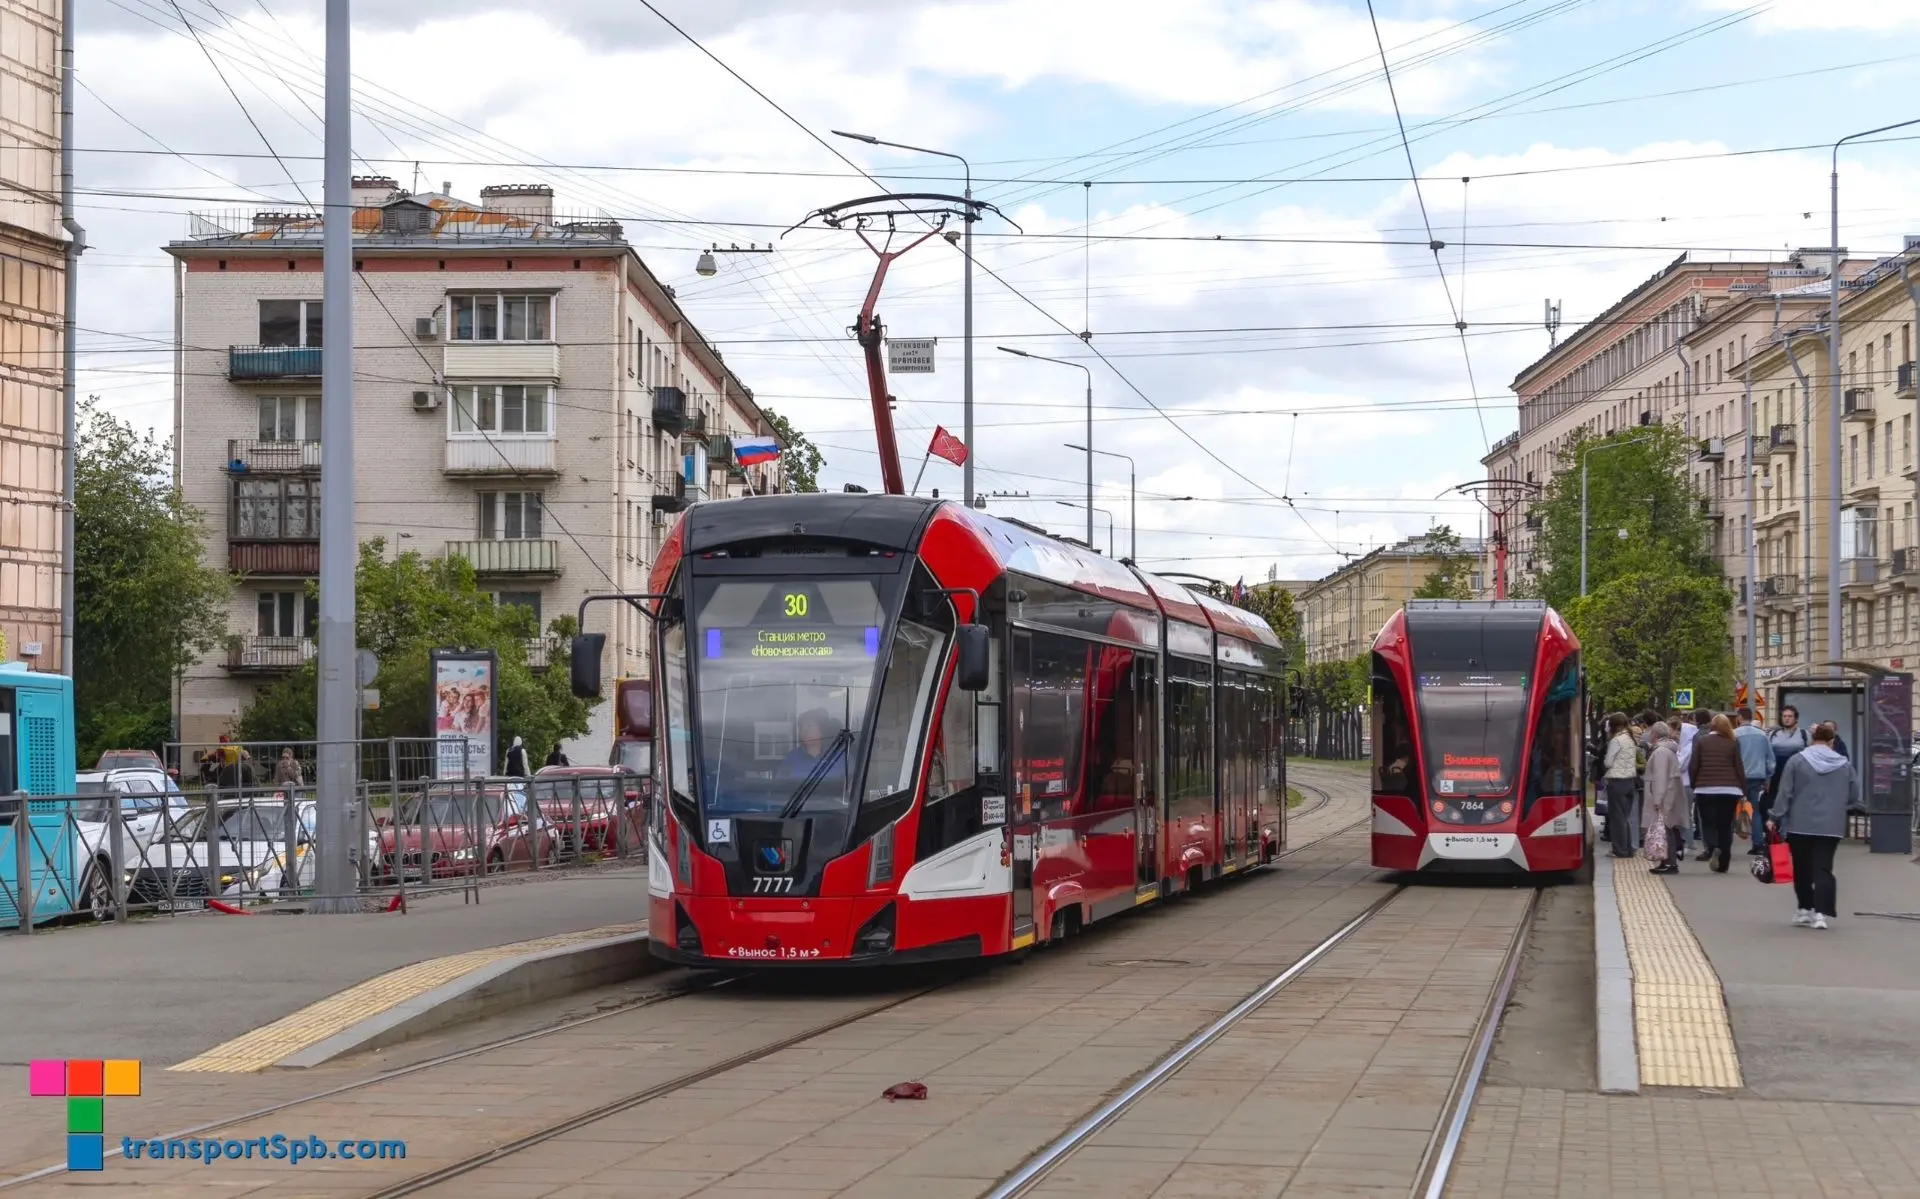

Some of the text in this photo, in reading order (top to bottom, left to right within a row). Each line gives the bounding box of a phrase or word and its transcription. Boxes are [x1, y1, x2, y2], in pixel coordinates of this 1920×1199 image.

[784, 594, 808, 616] 30
[758, 630, 826, 643] Станция метро
[454, 744, 486, 754] СЧСТЬЕ
[1460, 801, 1484, 810] 7864
[753, 877, 794, 893] 7777
[738, 947, 809, 958] Вынос 1,5 м
